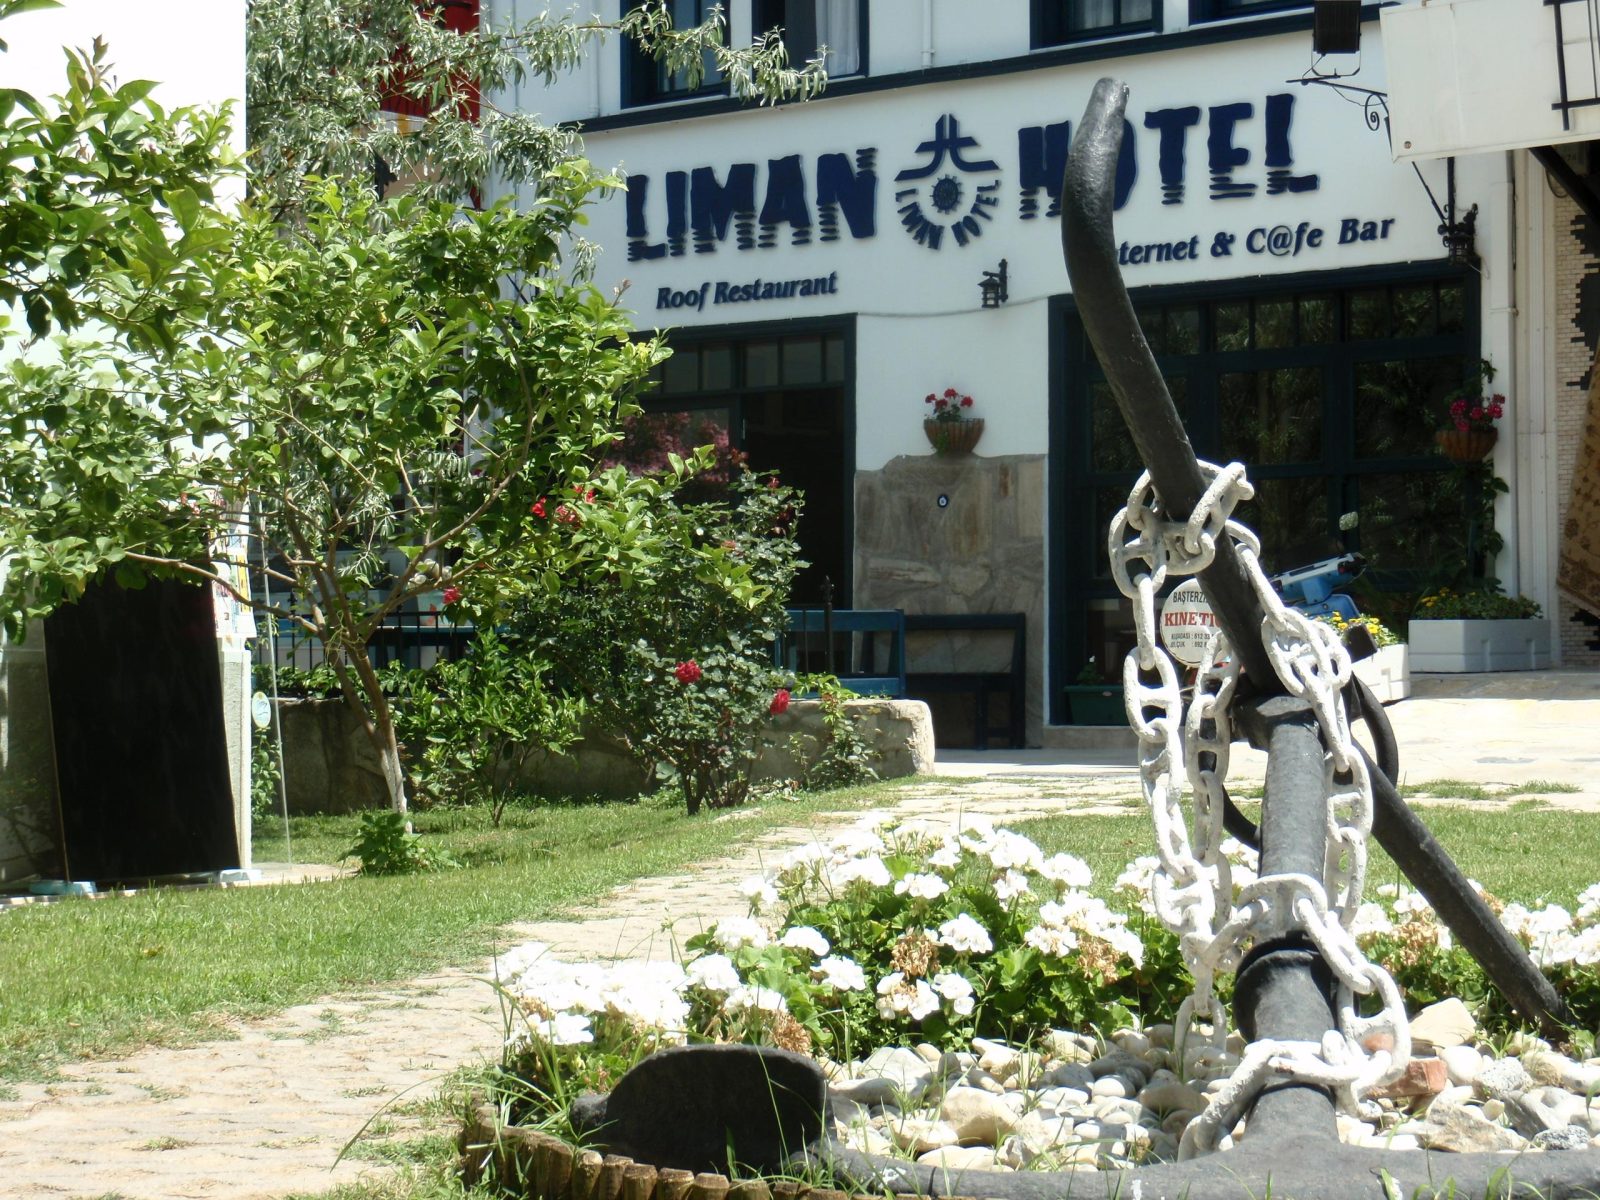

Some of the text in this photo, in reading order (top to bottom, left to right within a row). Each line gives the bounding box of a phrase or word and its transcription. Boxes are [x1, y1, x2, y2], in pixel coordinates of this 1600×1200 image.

[626, 148, 877, 262] LIMAN
[1210, 231, 1236, 257] &
[1246, 223, 1323, 257] C@fe
[1338, 217, 1395, 246] Bar
[656, 272, 838, 312] Roof Restaurant
